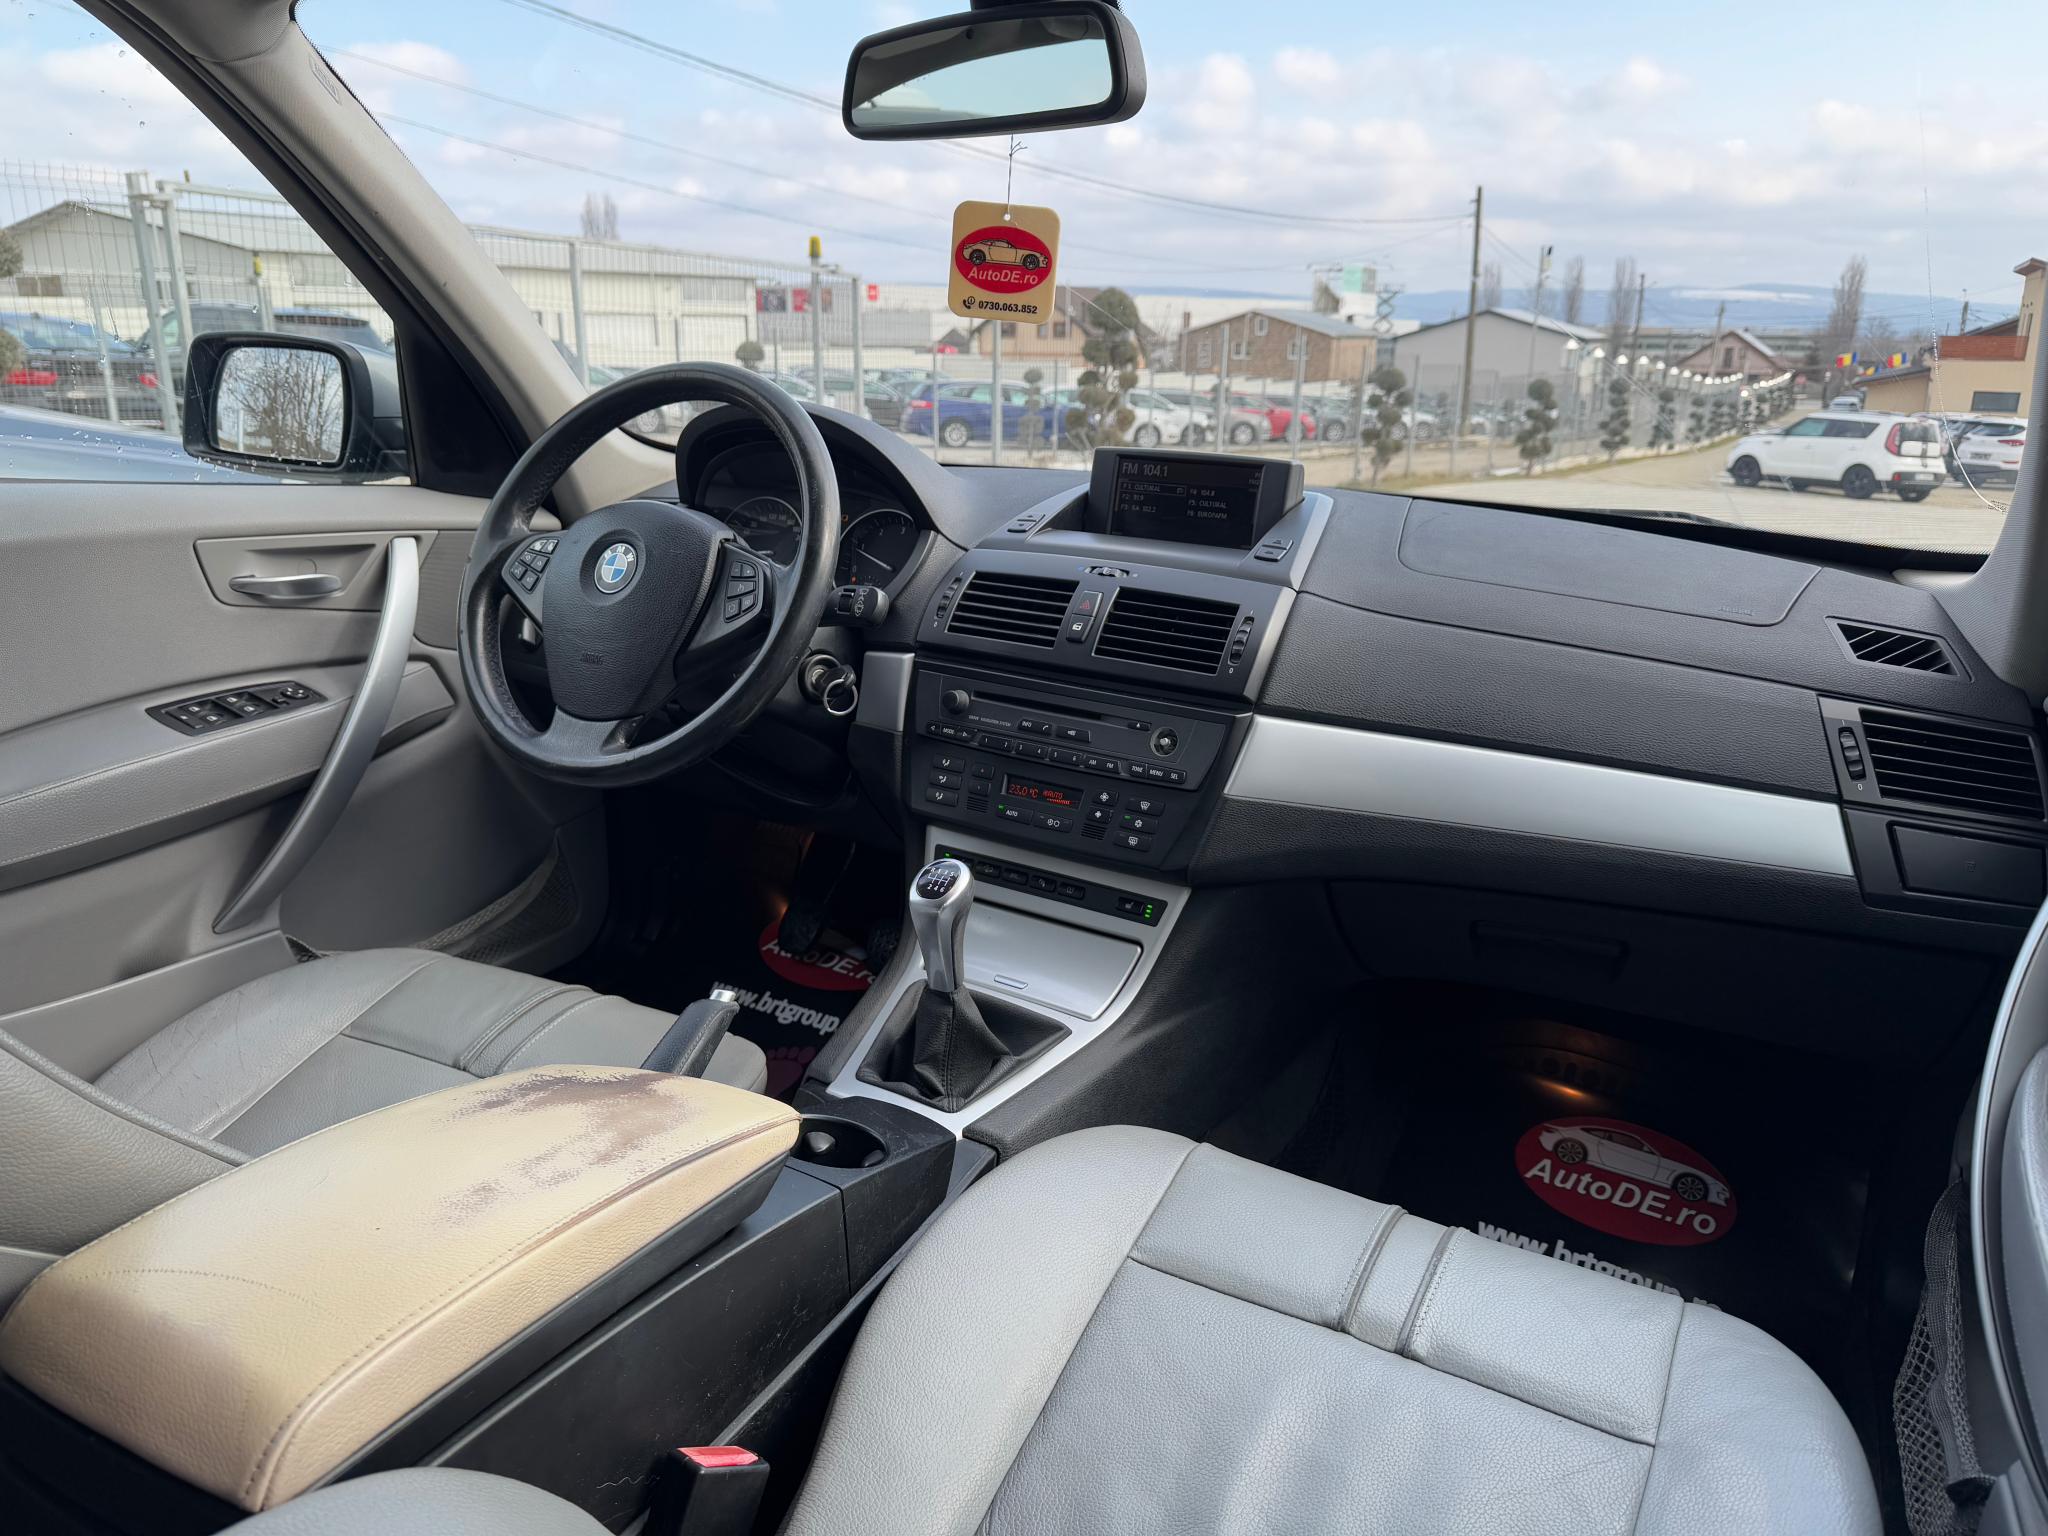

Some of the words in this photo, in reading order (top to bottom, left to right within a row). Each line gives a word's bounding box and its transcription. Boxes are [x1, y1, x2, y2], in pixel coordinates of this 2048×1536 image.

[967, 266, 1038, 285] AutoDE.ro
[978, 300, 1038, 314] 0730.063.852
[1122, 462, 1139, 474] FM
[1143, 463, 1168, 477] 104.1
[603, 545, 635, 562] BMW
[942, 727, 955, 735] MODE
[1131, 765, 1143, 773] TONE
[1149, 768, 1164, 777] MENU
[1170, 772, 1179, 780] SEL
[1005, 809, 1018, 817] AUTO
[1524, 1159, 1717, 1236] AutoDE.ro
